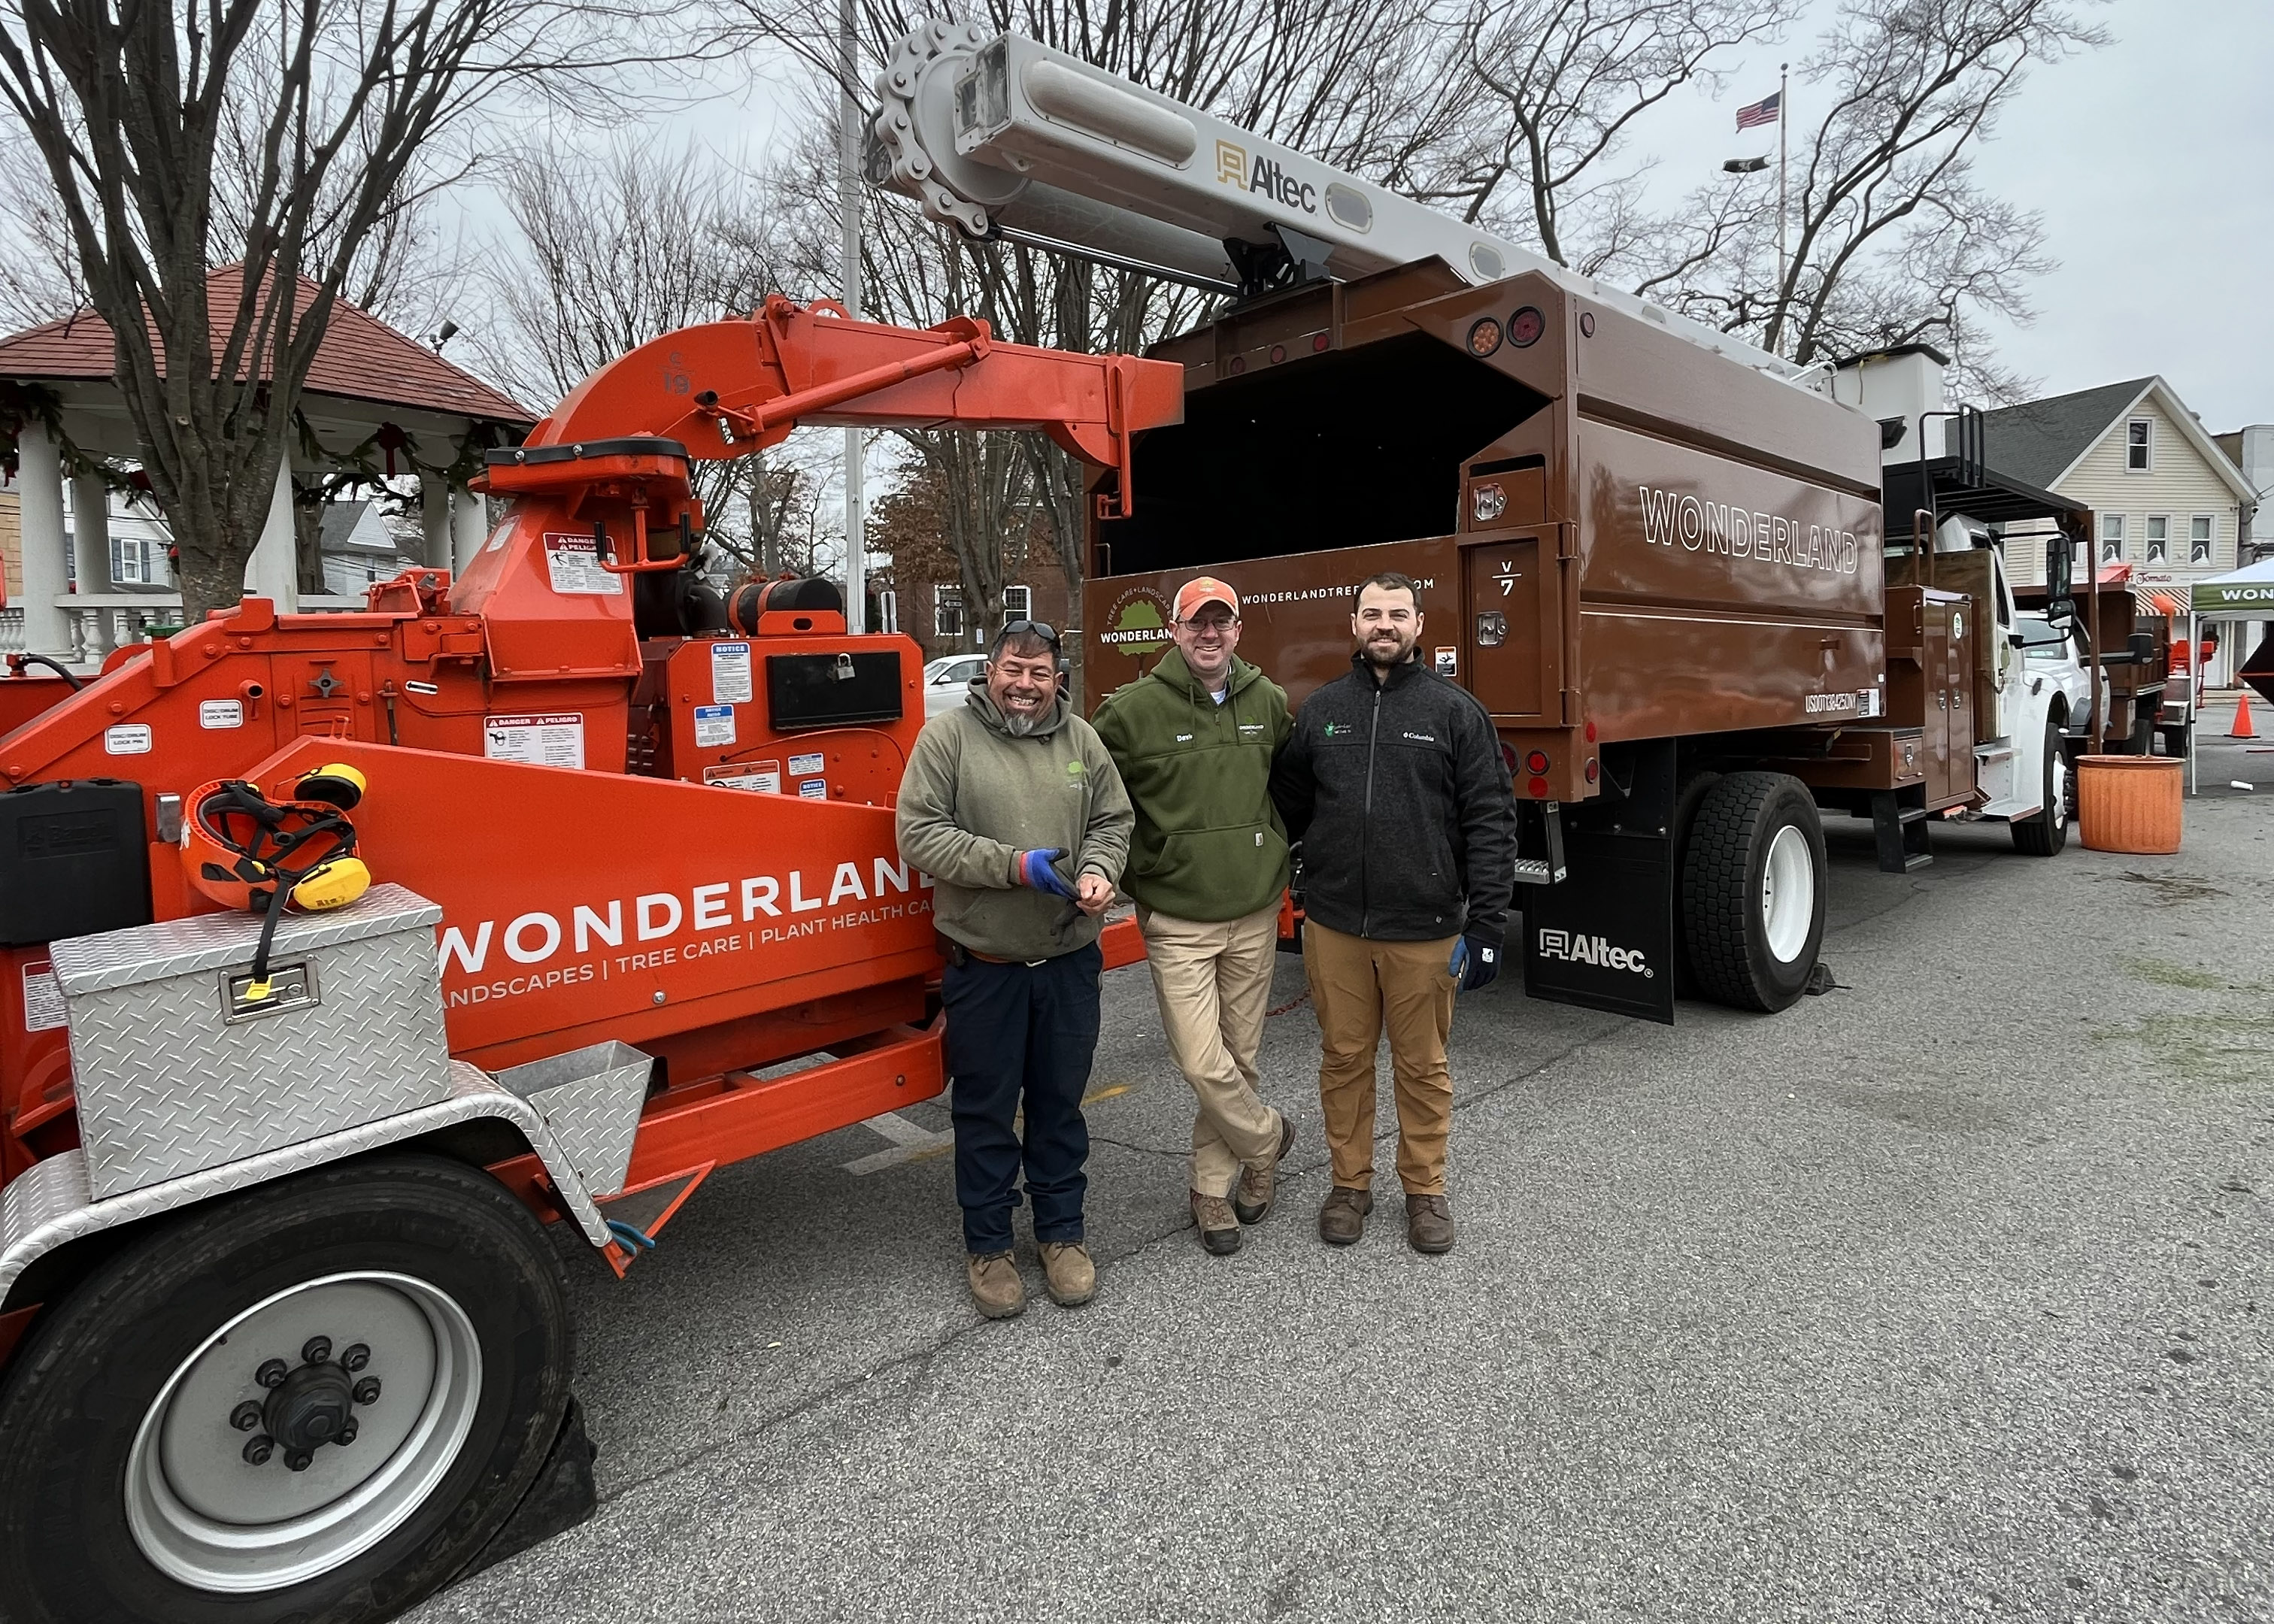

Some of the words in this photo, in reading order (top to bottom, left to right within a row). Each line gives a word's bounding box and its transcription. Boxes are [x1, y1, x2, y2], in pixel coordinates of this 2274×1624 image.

[1249, 155, 1316, 214] Altec
[1639, 486, 1858, 574] WONDERLAND
[1501, 561, 1512, 572] V
[1107, 603, 1117, 626] TREE
[1117, 588, 1133, 604] CARE
[1500, 580, 1513, 596] 7
[1100, 628, 1172, 644] WONDERLAN
[1408, 732, 1434, 742] Columbia
[437, 856, 935, 979] WONDERLAN
[443, 964, 594, 1010] NDSCAPES
[616, 947, 677, 974] TREE
[683, 935, 741, 960] CARE
[760, 918, 826, 944] PLANT
[832, 903, 903, 931] HEALTH
[908, 899, 935, 916] CA
[1569, 934, 1645, 973] Altec
